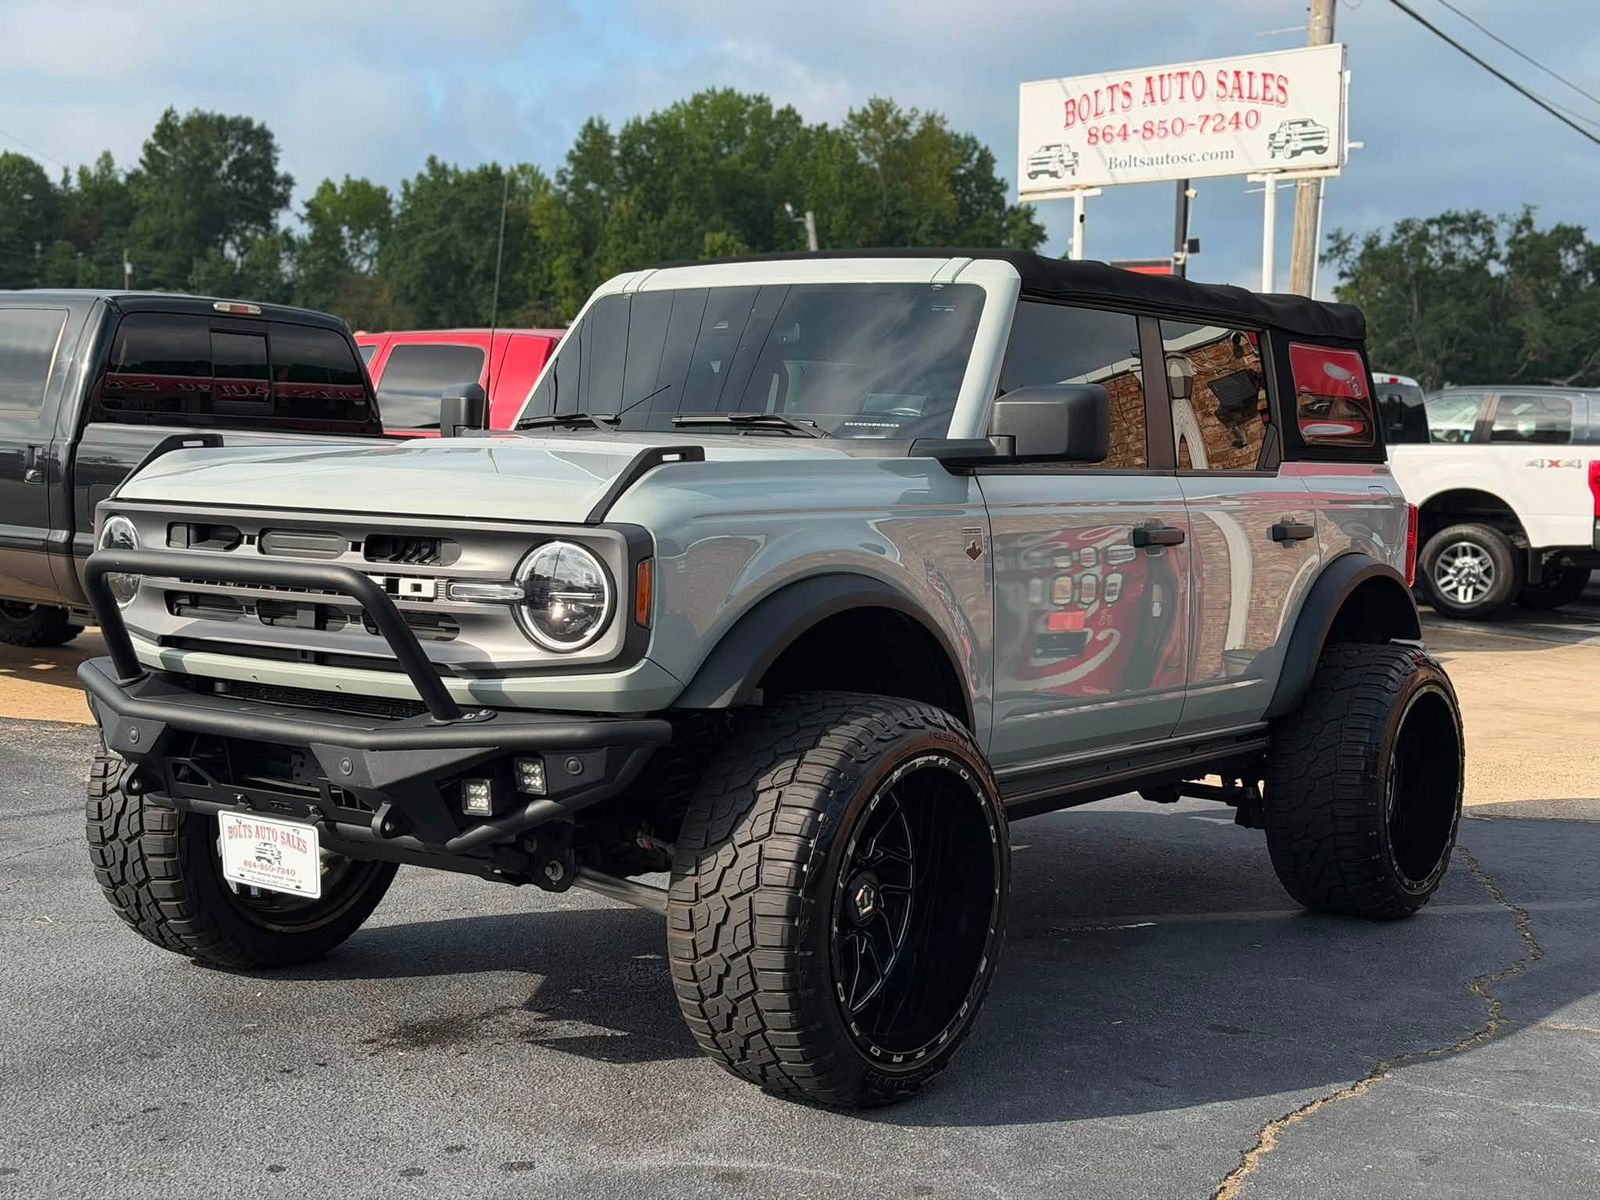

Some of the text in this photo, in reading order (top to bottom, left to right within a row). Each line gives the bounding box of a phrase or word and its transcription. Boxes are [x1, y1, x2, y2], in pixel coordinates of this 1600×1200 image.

[1063, 69, 1289, 130] BOLTS AUTO SALES
[1087, 109, 1261, 146] 864-850-7240
[1108, 149, 1235, 170] Boltsautosc.com
[227, 824, 307, 854] BOLTS AUTO SALES
